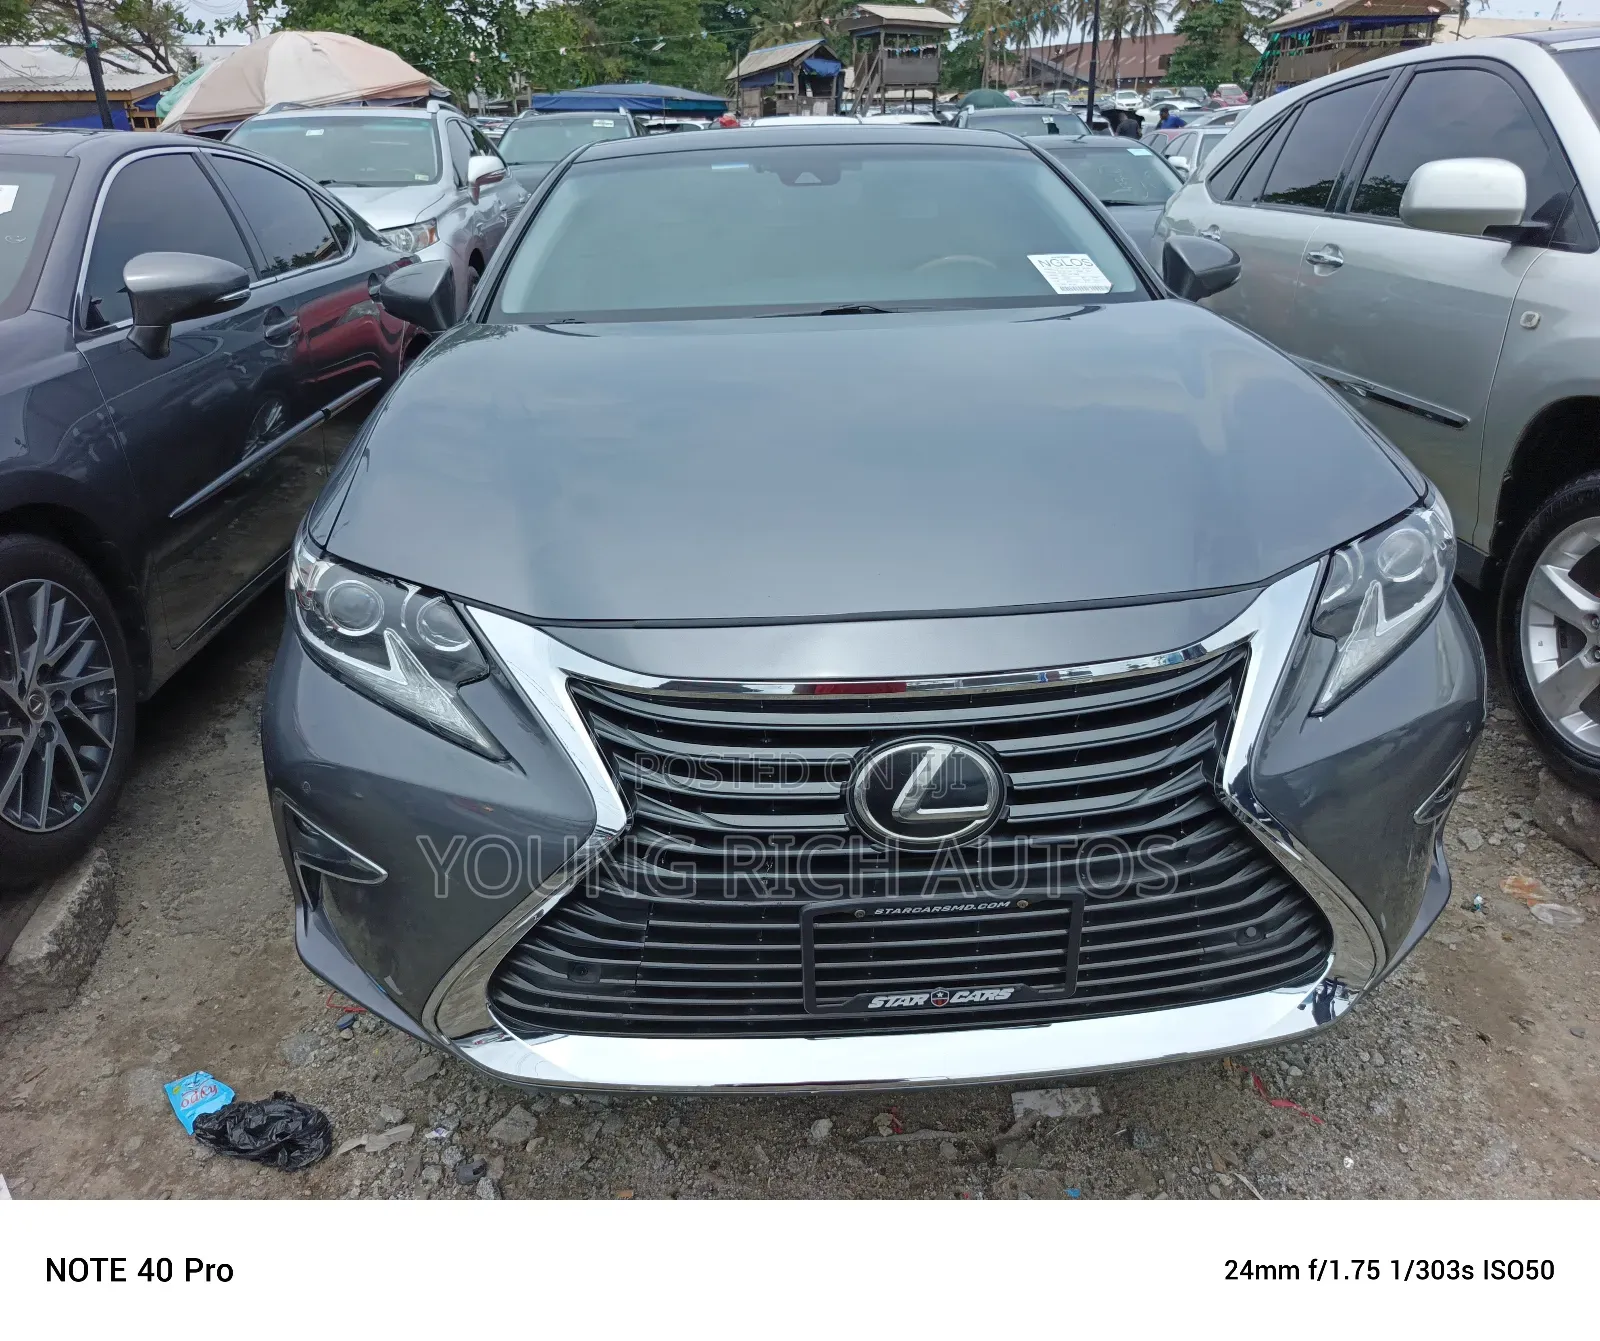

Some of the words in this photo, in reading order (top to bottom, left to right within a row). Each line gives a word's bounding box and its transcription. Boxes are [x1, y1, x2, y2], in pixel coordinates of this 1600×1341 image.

[1037, 258, 1094, 267] NGLOS
[874, 901, 1011, 915] STARCARSMD.COM
[867, 993, 930, 1009] STAR
[949, 987, 1015, 1003] CARS
